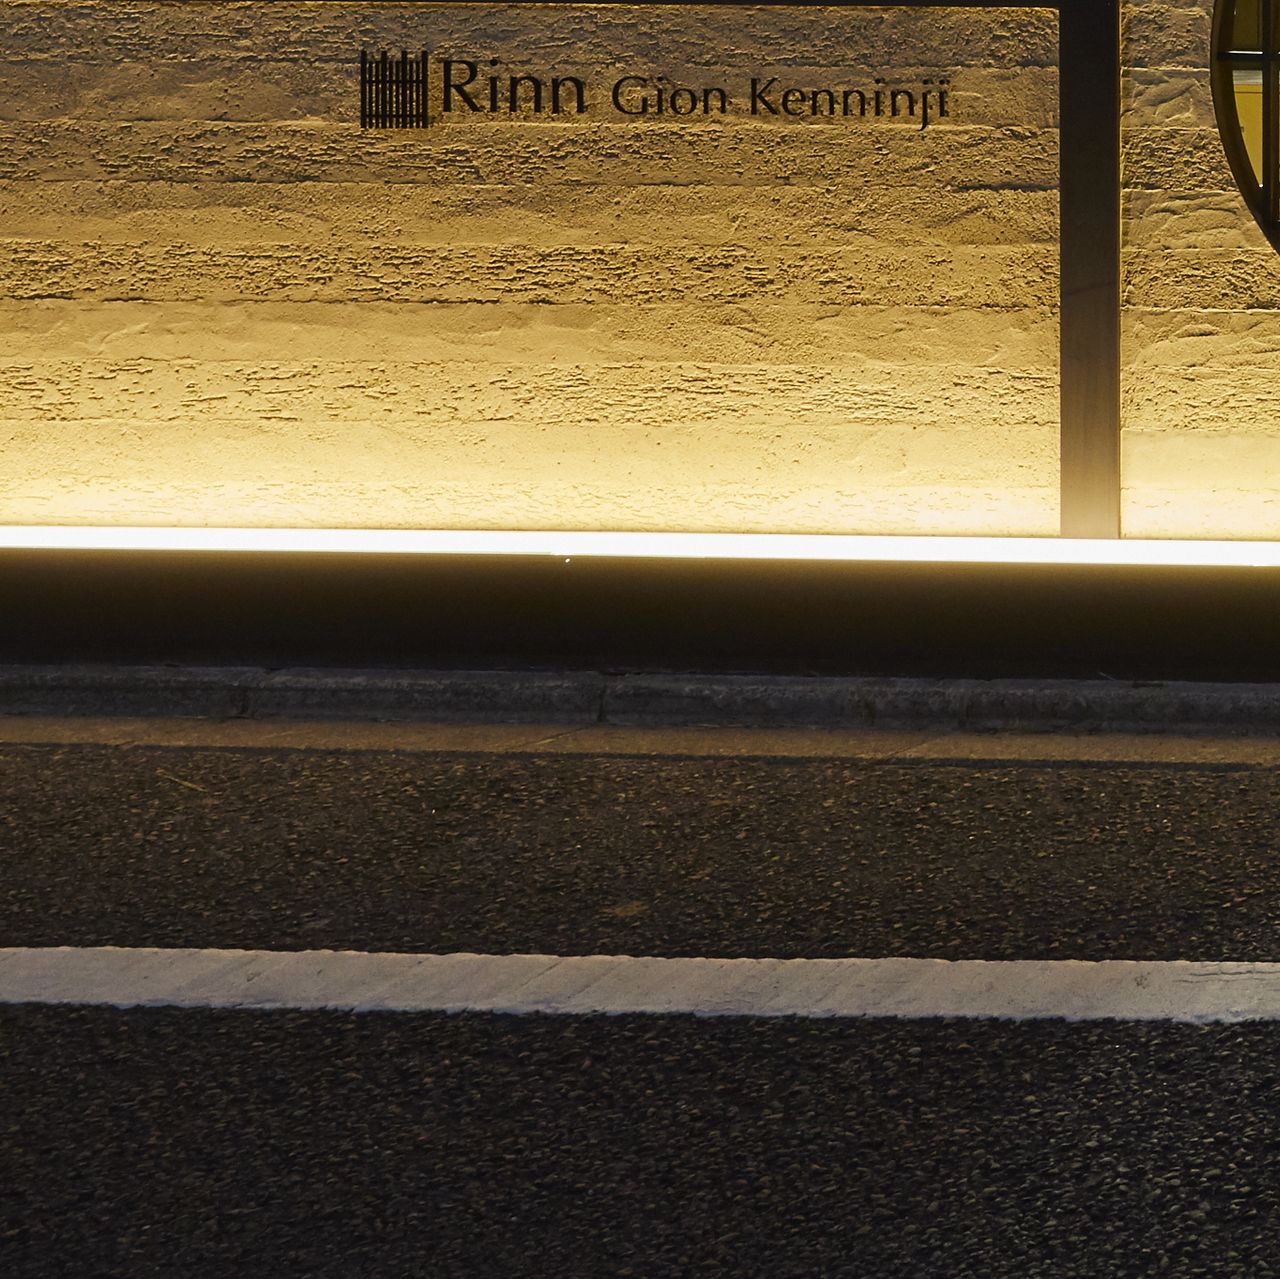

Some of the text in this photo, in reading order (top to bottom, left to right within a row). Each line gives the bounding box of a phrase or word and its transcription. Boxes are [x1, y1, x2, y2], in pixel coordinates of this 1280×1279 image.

[442, 58, 951, 132] Rinn Gion Kenninji
